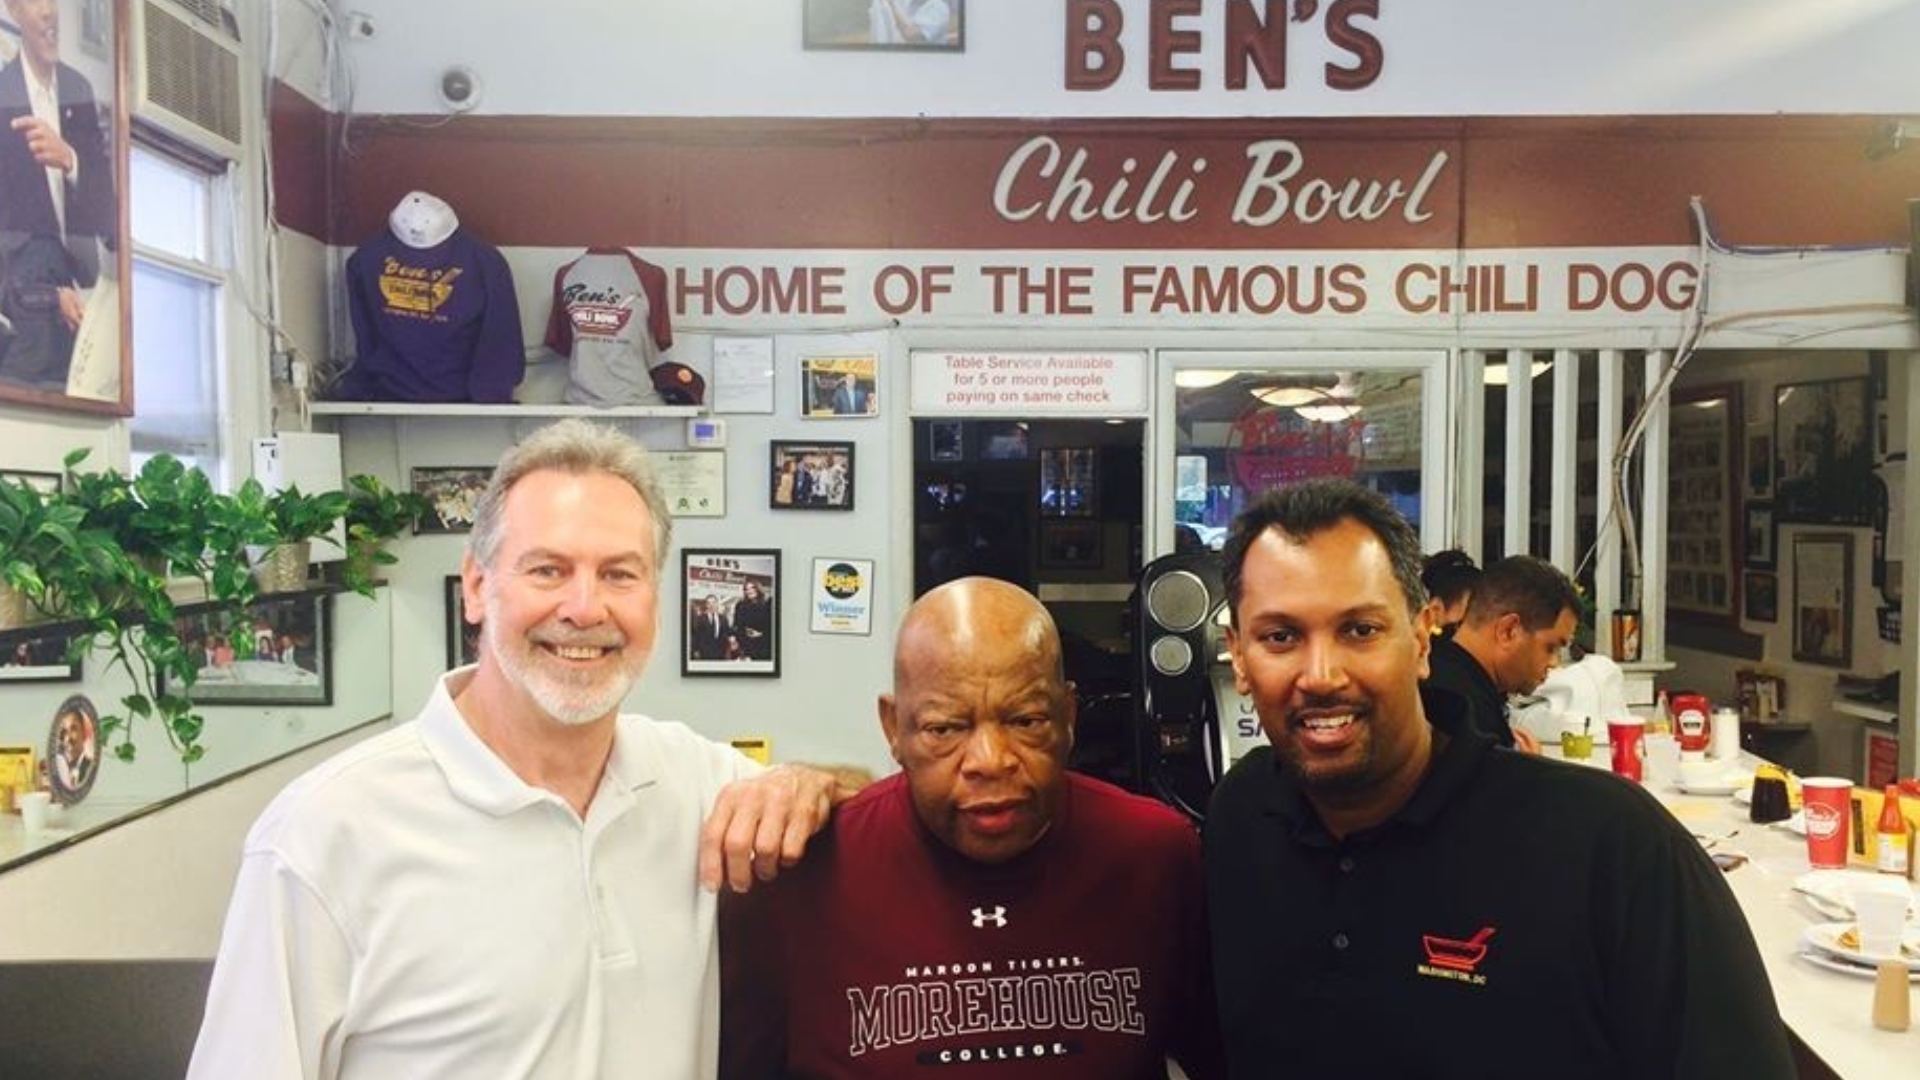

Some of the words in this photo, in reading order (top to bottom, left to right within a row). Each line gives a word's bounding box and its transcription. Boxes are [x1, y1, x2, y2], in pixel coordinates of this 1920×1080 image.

[1065, 0, 1385, 91] BEN'S
[992, 134, 1207, 224] Chili
[1231, 138, 1450, 227] Bowl
[674, 266, 847, 316] HOME
[873, 264, 955, 316] OF
[980, 265, 1095, 315] THE
[1122, 264, 1368, 315] FAMOUS
[1395, 263, 1540, 314] CHILI
[1567, 261, 1700, 312] DOG
[945, 355, 984, 369] Table
[988, 355, 1042, 369] Service
[1047, 356, 1114, 370] Available
[954, 373, 974, 386] for
[978, 373, 988, 386] 5
[992, 376, 1007, 386] or
[1012, 376, 1048, 386] more
[1053, 374, 1104, 388] people
[946, 391, 996, 405] paying
[1001, 392, 1018, 402] on
[1022, 392, 1063, 402] same
[1066, 390, 1111, 402] check
[905, 961, 993, 977] MAROON
[1008, 956, 1081, 970] TIGERS
[847, 967, 1145, 1057] MOREHOUSE
[940, 1043, 1063, 1062] COLLEGE
